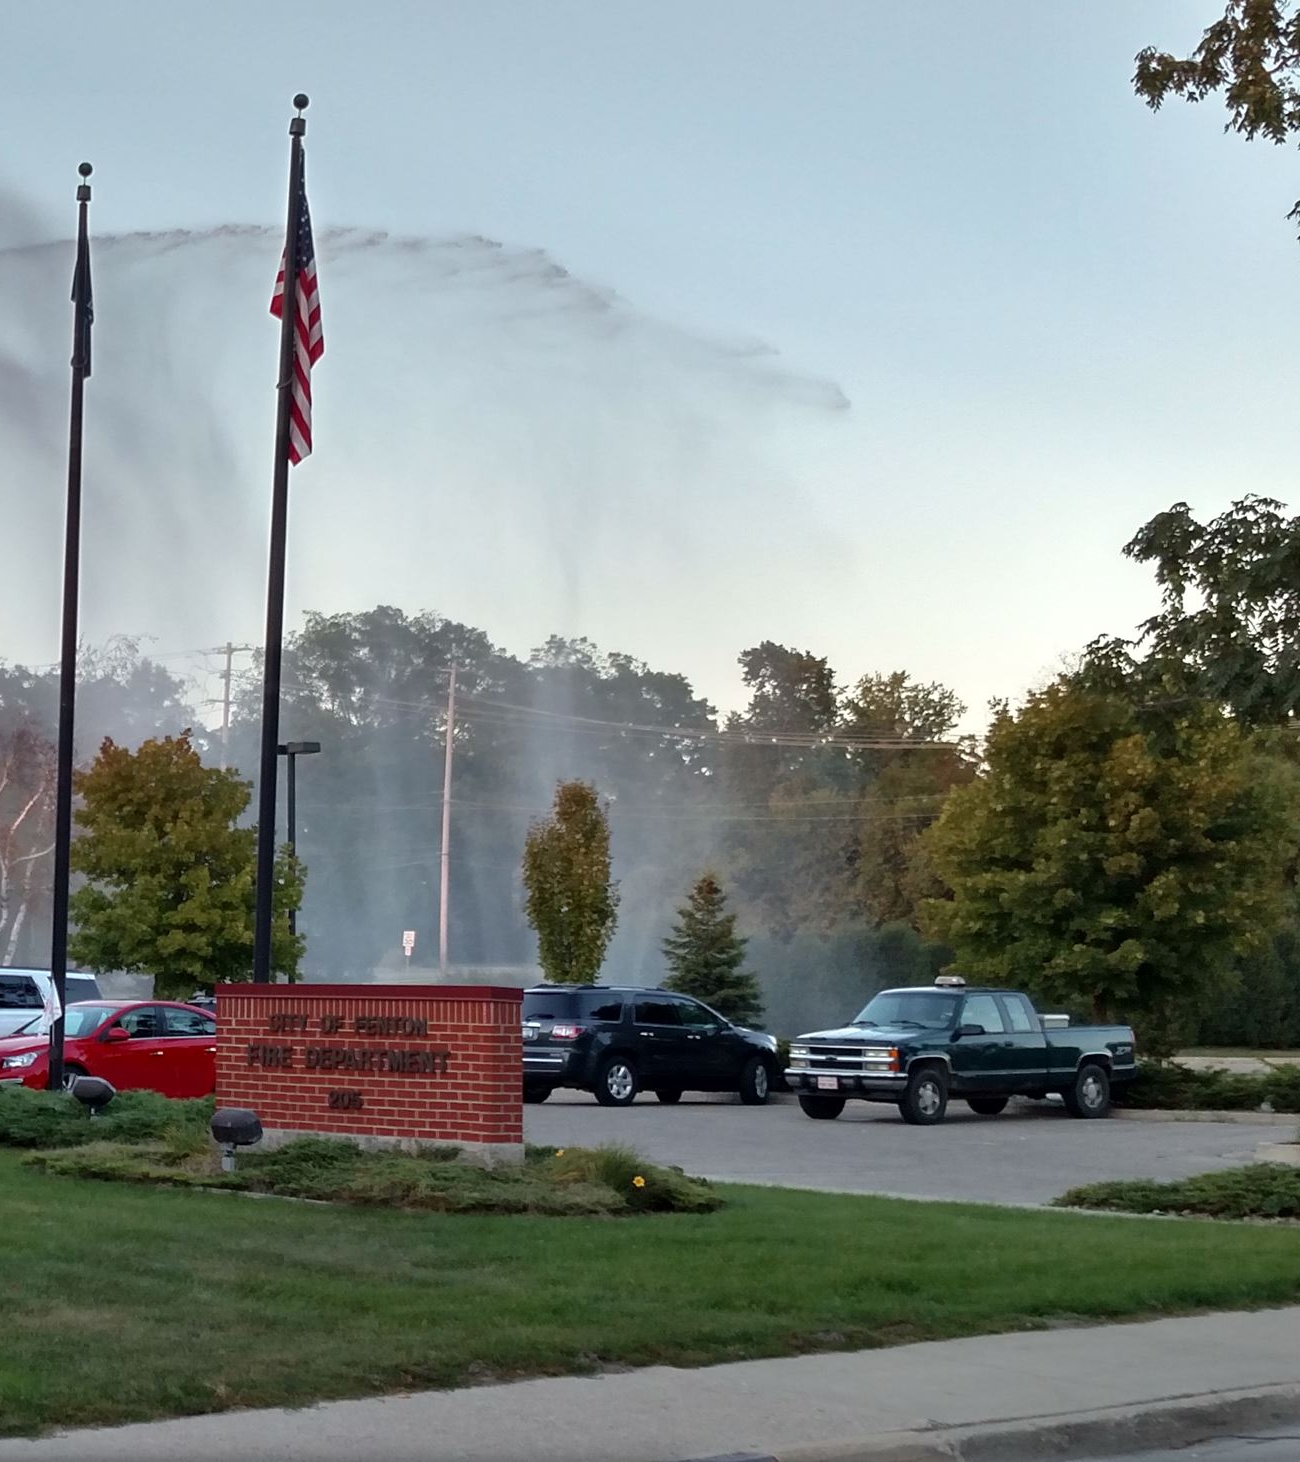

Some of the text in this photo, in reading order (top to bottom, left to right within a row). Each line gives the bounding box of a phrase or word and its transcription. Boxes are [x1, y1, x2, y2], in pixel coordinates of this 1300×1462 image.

[268, 1014, 428, 1037] CITY OF FENTON
[248, 1045, 449, 1073] FIRE DEPARTMENT
